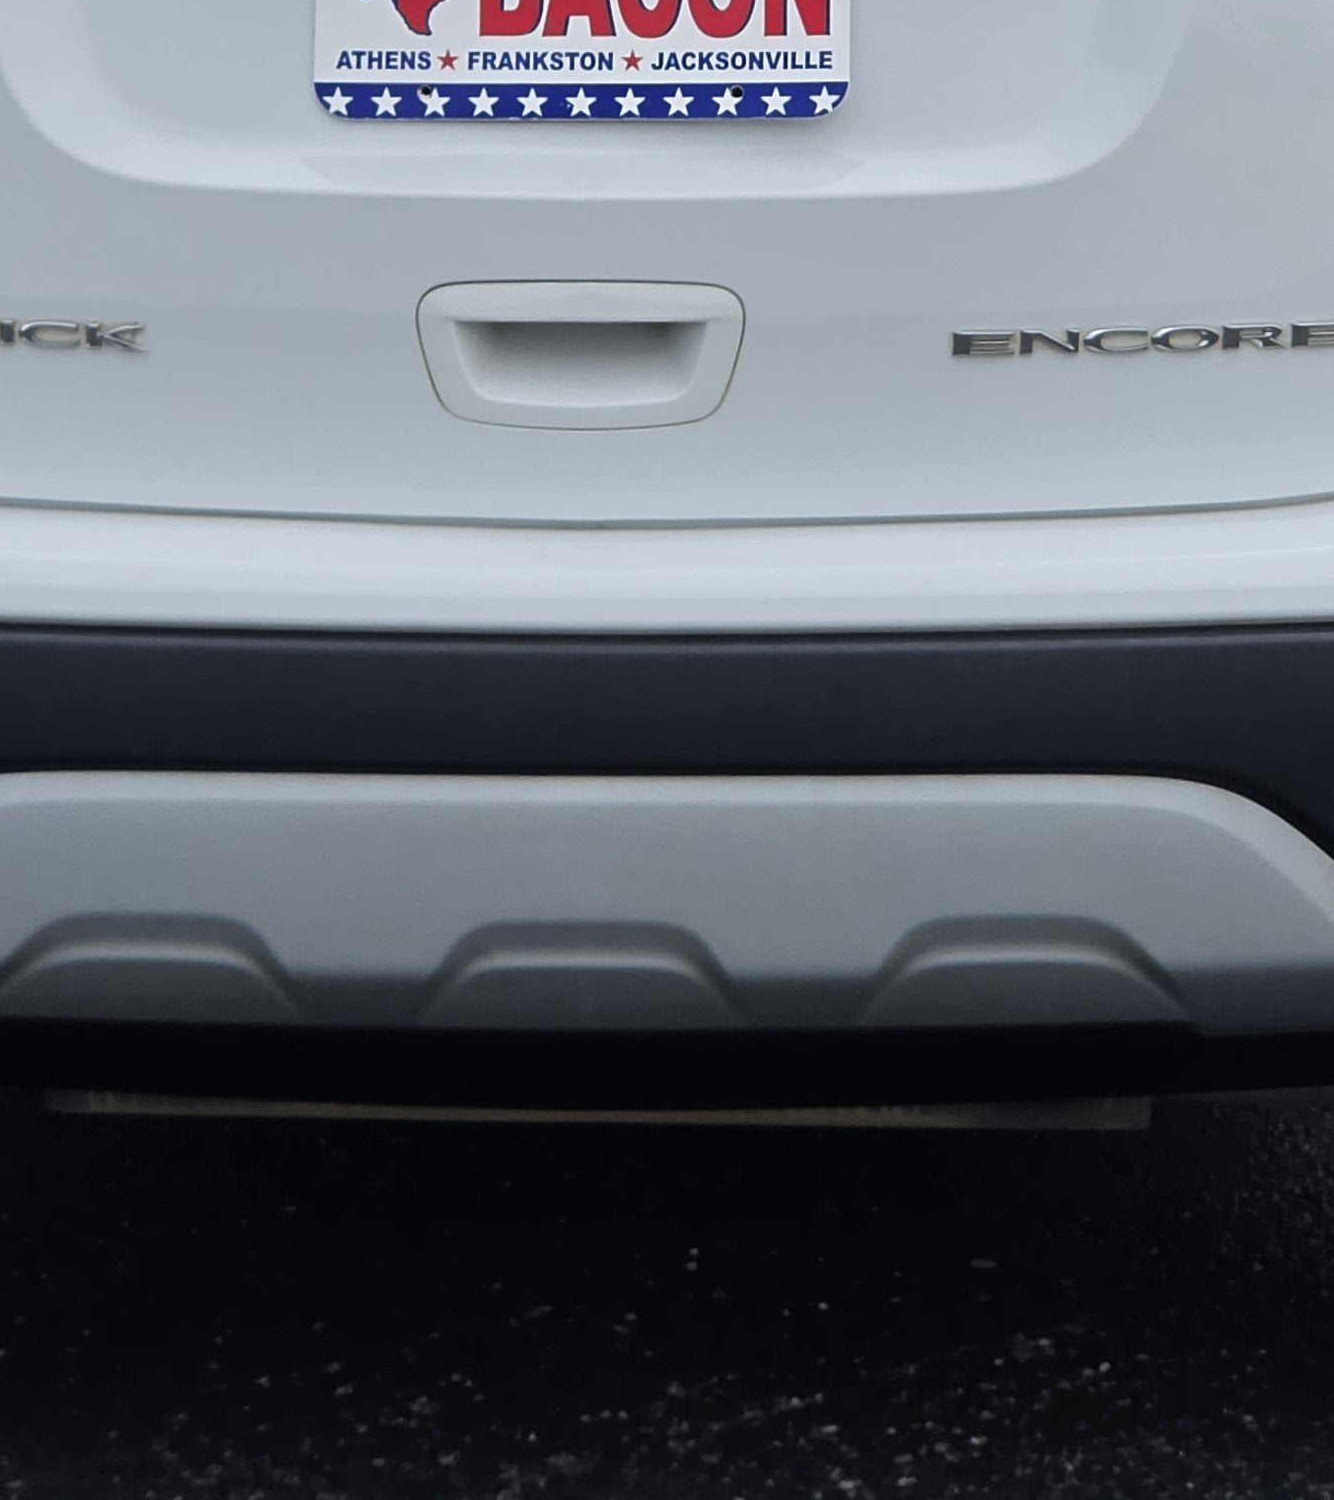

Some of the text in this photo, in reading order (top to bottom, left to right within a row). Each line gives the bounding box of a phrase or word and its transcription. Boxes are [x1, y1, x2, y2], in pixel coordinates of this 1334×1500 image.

[335, 50, 834, 71] ATHENS FRANKSTON JACKSONVILLE
